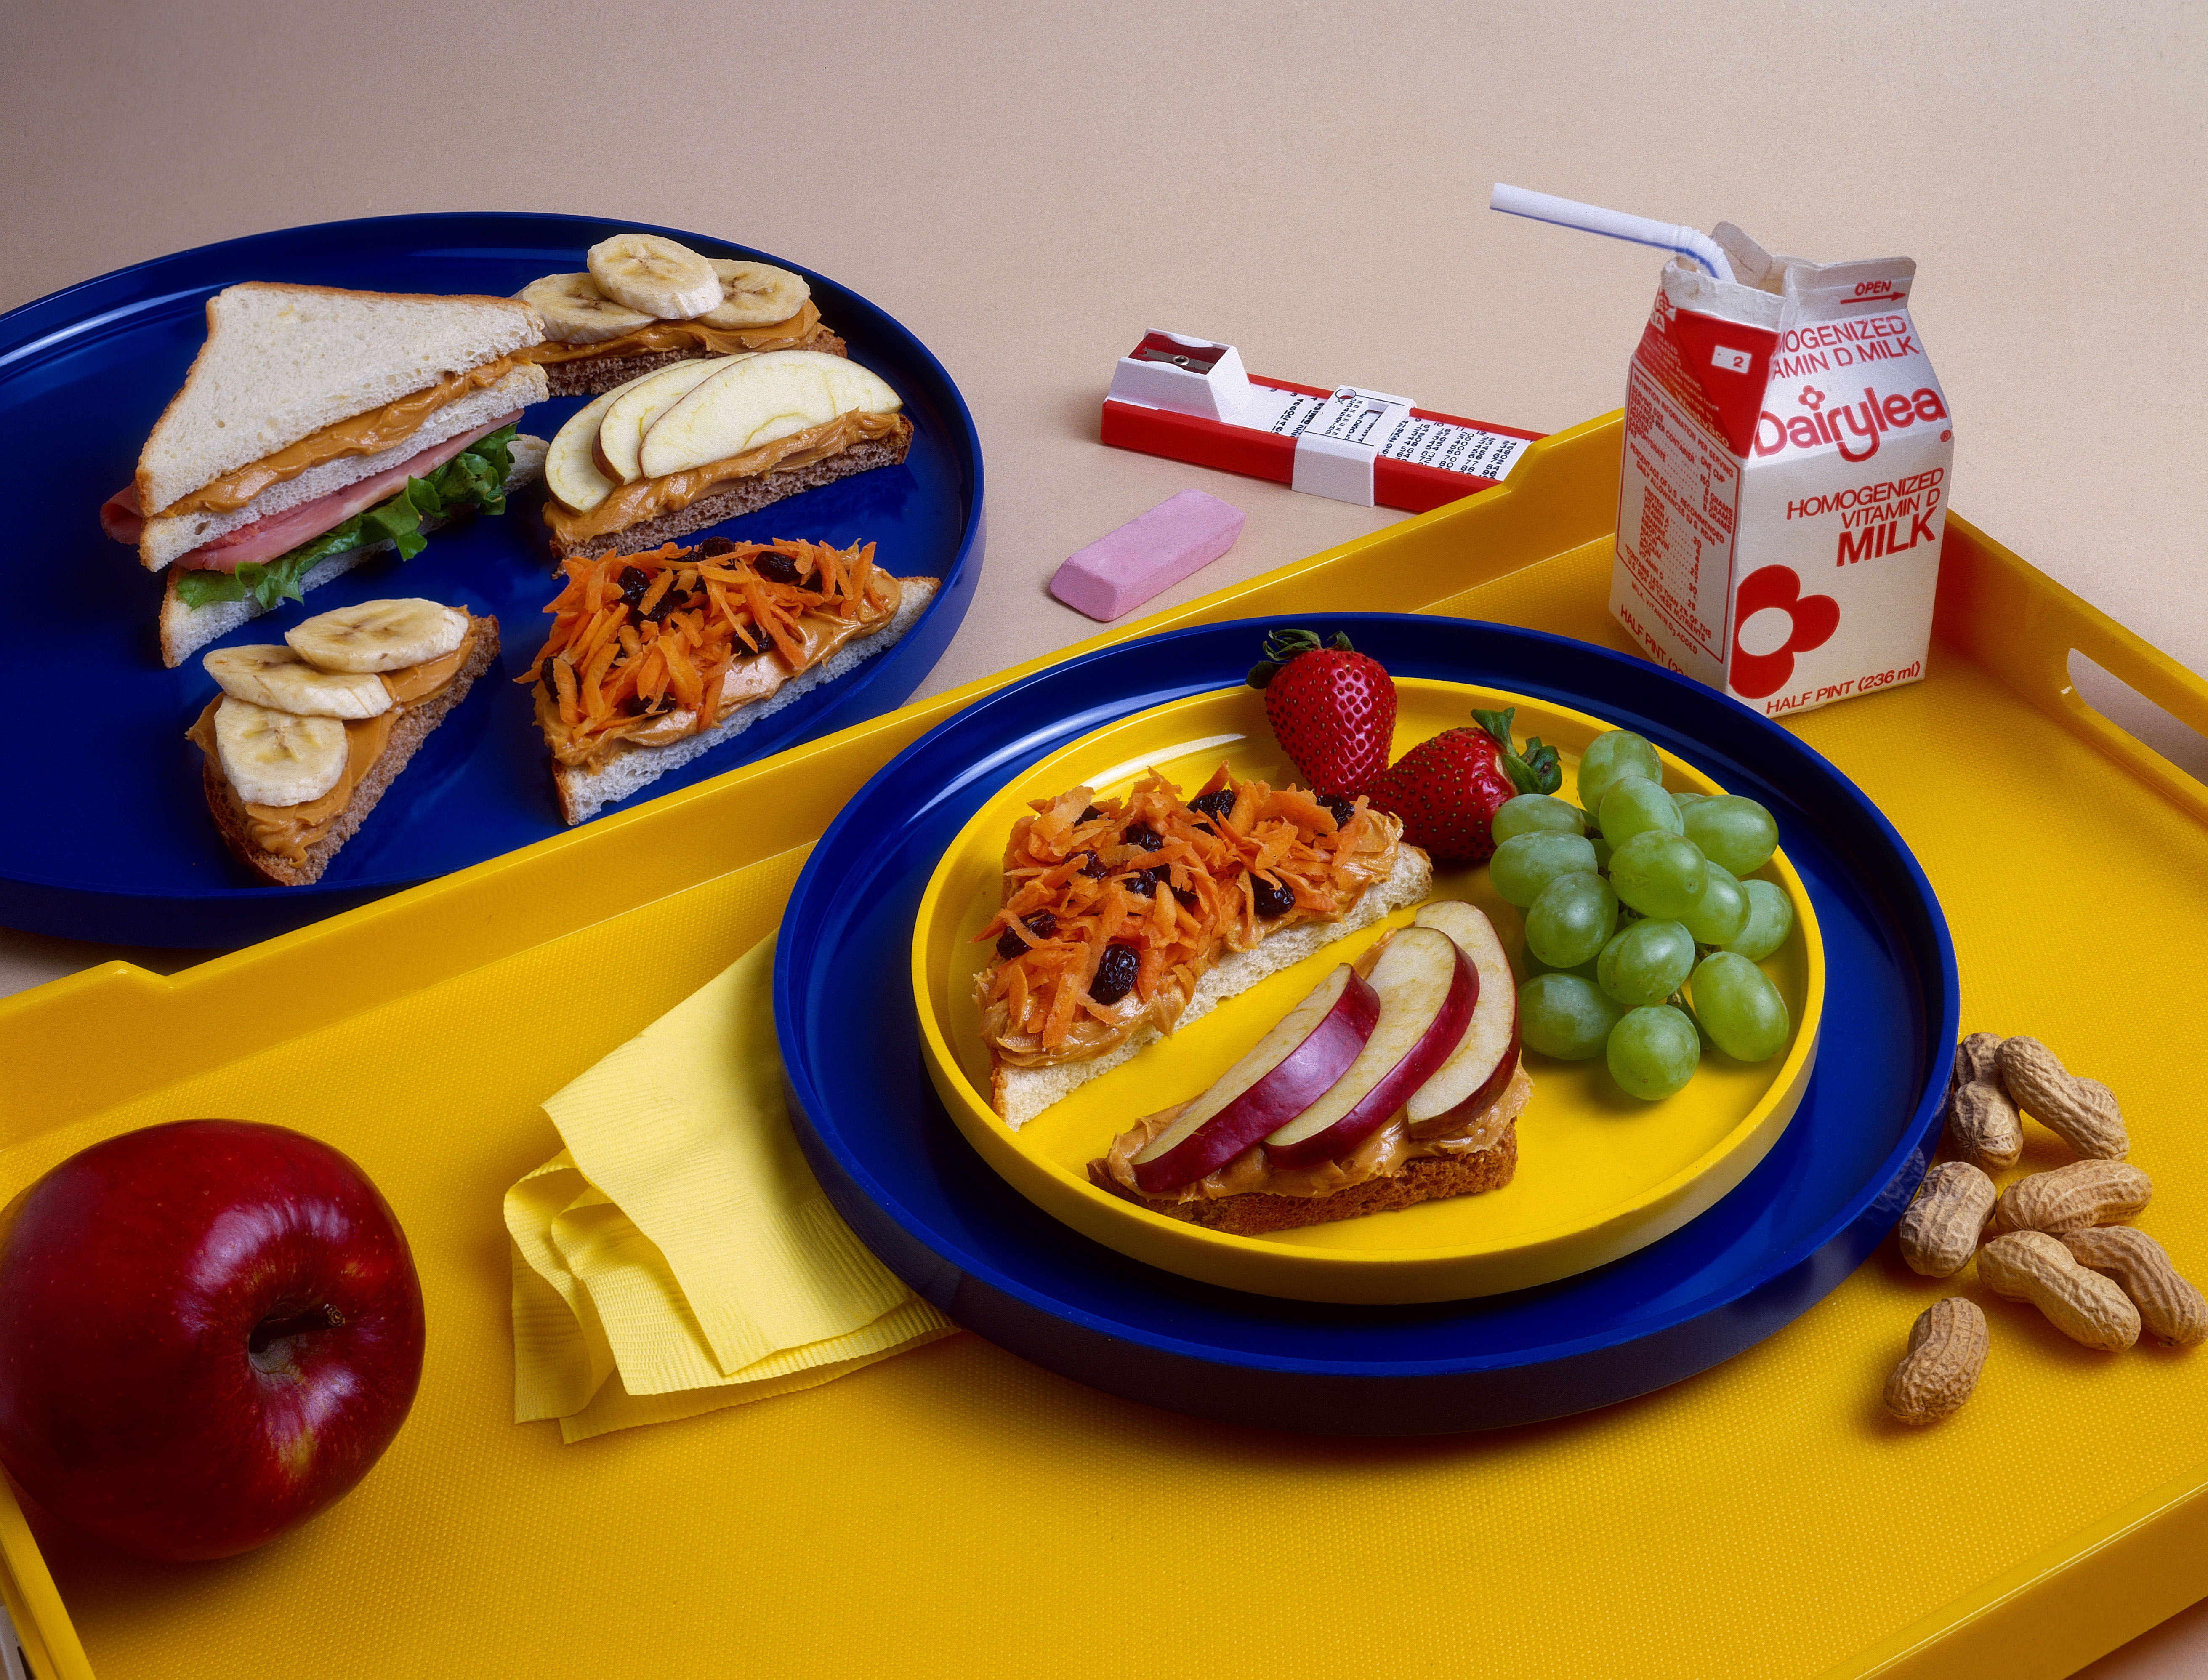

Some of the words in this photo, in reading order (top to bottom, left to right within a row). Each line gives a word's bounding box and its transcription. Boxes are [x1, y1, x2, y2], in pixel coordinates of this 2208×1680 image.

[1854, 281, 1891, 296] OPEN
[1676, 366, 1702, 391] PENDING
[1733, 356, 1744, 367] 2
[1833, 347, 1853, 366] D
[1855, 336, 1920, 362] MILK
[1630, 401, 1652, 429] CALORIES
[1700, 474, 1710, 488] 150
[1631, 392, 1655, 423] SERVINGS
[1655, 419, 1665, 432] PER
[1665, 430, 1694, 463] CONTAINER
[1631, 385, 1652, 411] SERVING
[1653, 407, 1663, 423] SIZE
[1700, 456, 1712, 472] ONE
[1713, 468, 1725, 482] CUP
[1634, 373, 1660, 404] NUTRITION
[1661, 402, 1696, 441] INFORMATION
[1697, 438, 1708, 452] PER
[1709, 450, 1733, 478] SERVING
[1754, 387, 1947, 462] Dairylea
[1482, 469, 1497, 478] 96
[1628, 417, 1665, 462] CARBOHYDRATE
[1709, 498, 1732, 528] GRAMS
[1629, 410, 1649, 434] PROTEIN
[1710, 493, 1733, 519] GRAMS
[1630, 442, 1659, 479] PERCENTAGE
[1660, 476, 1667, 486] OF
[1680, 497, 1724, 543] RECOMMENDED
[1636, 460, 1650, 478] DAILY
[1650, 477, 1684, 516] ALLOWANCES
[1700, 527, 1715, 546] RDA)
[1644, 496, 1664, 519] VITAMIN
[1644, 503, 1663, 526] VITAMIN
[1664, 524, 1668, 532] C
[1644, 486, 1665, 511] PROTEIN
[1693, 536, 1702, 550] 20
[1708, 506, 1731, 534] GRAMS
[1787, 468, 1944, 520] HOMOGENIZED
[1841, 493, 1920, 529] VITAMIN
[1926, 488, 1940, 507] D
[1641, 516, 1669, 551] RIBOFLAVIN
[1642, 509, 1665, 538] THIAMINE
[1836, 506, 1937, 567] MILK
[1639, 551, 1658, 574] VITAMIN
[1640, 532, 1661, 559] CALCIUM
[1689, 583, 1697, 595] 30
[1620, 604, 1643, 636] HALF
[1645, 632, 1665, 663] PINT
[1637, 568, 1647, 583] RDA
[1648, 580, 1655, 590] OF
[1657, 590, 1672, 611] THESE
[1673, 603, 1705, 642] NUTRIENTS
[1646, 599, 1668, 625] VITAMIN
[1676, 631, 1697, 654] ADDED
[1650, 574, 1663, 592] LESS
[1664, 589, 1678, 607] THAN
[1679, 604, 1688, 617] 2%
[1689, 614, 1698, 624] OF
[1700, 623, 1711, 639] THE
[1766, 691, 1813, 714] HALF
[1816, 680, 1854, 701] PINT
[1858, 670, 1894, 692] (236
[1897, 661, 1921, 680] ml)
